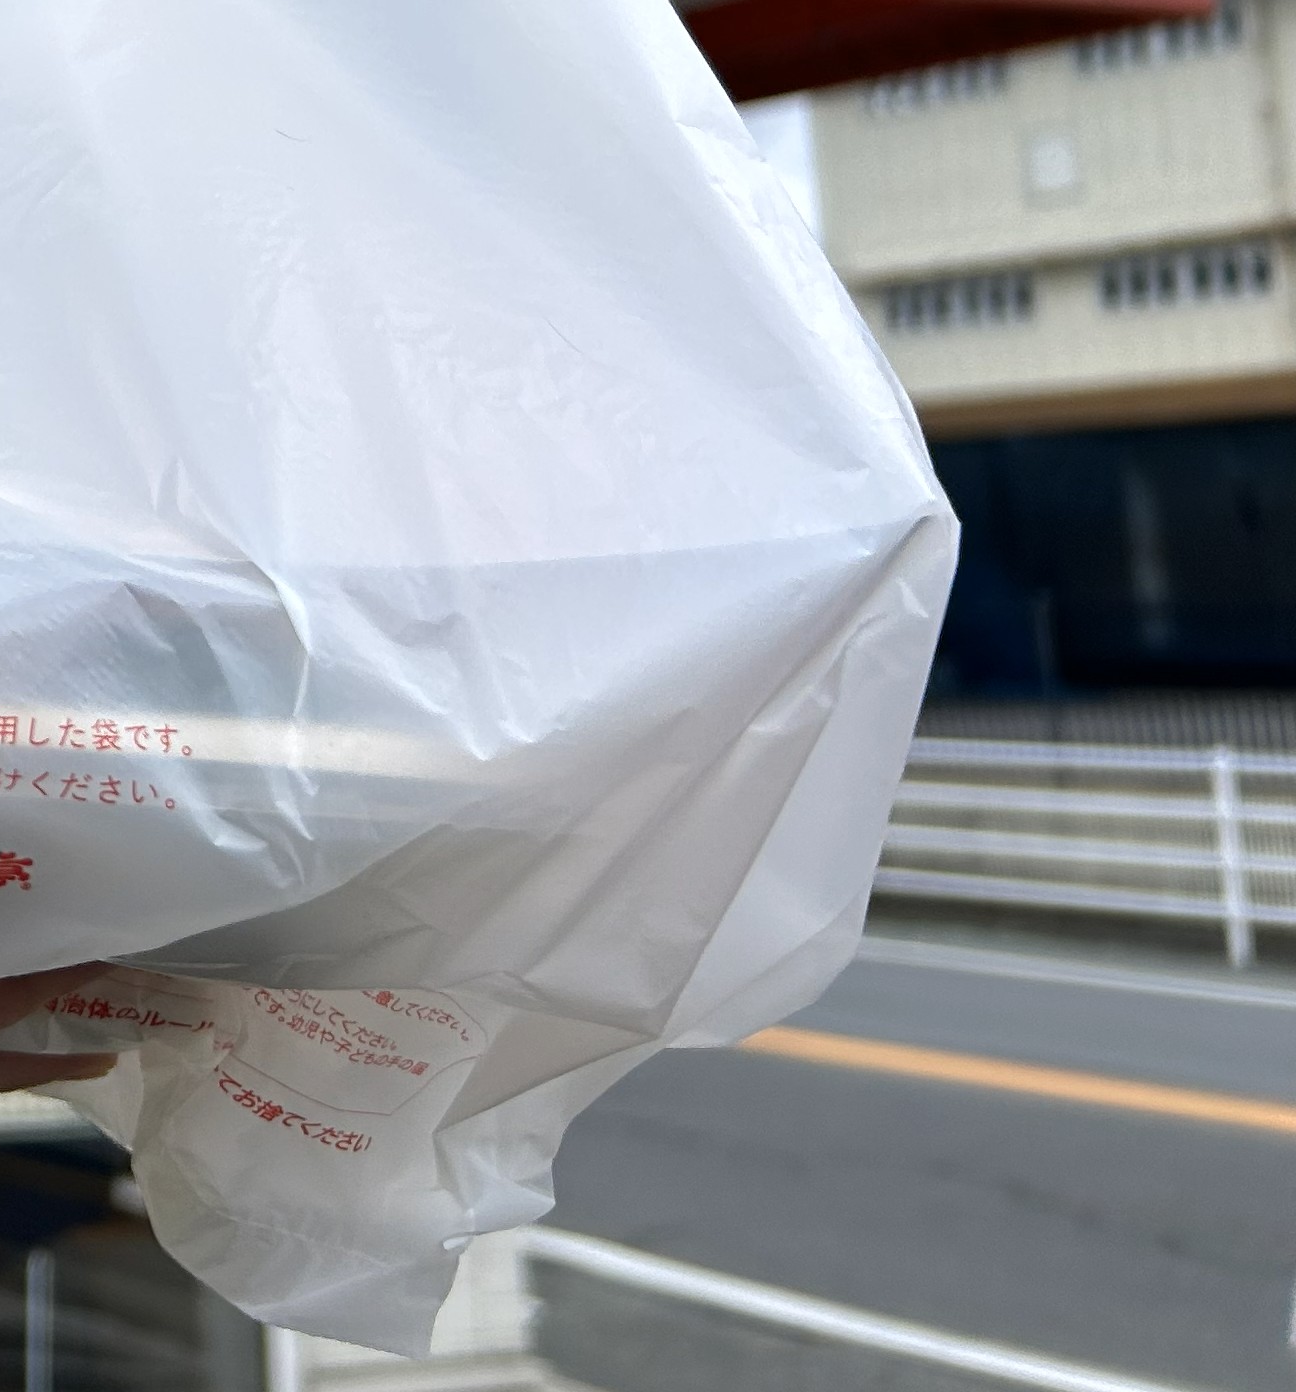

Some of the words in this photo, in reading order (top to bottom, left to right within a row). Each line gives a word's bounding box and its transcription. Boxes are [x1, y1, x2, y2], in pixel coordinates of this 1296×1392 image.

[214, 1064, 373, 1152] てお捨てください
